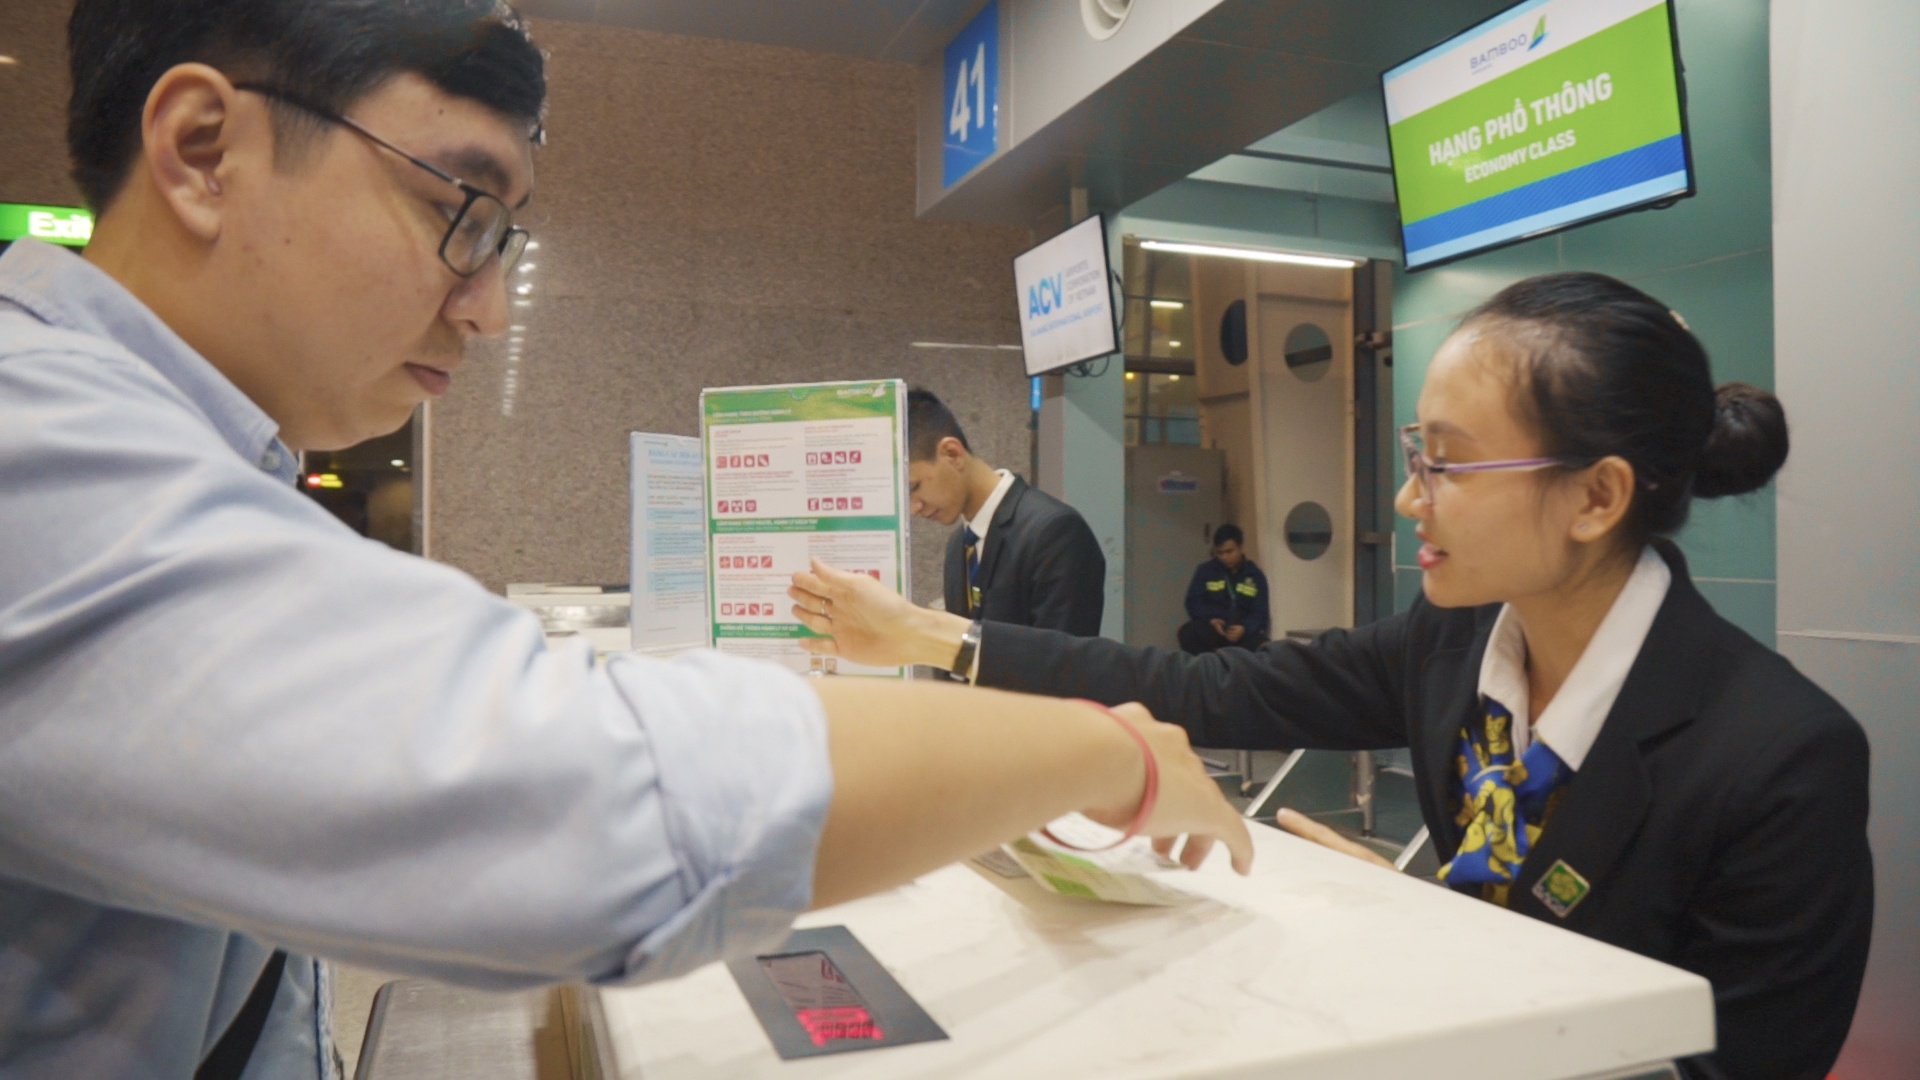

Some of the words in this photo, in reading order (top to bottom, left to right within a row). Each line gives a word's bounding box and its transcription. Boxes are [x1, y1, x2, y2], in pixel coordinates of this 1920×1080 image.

[1470, 33, 1528, 69] BAMBOO
[949, 42, 986, 143] 41
[1428, 126, 1482, 167] HẠNG
[1484, 97, 1528, 145] PHỔ
[1530, 72, 1612, 126] THÔNG
[1464, 147, 1527, 184] ECONOMY
[1528, 129, 1577, 160] CLASS
[1029, 271, 1063, 321] ACV
